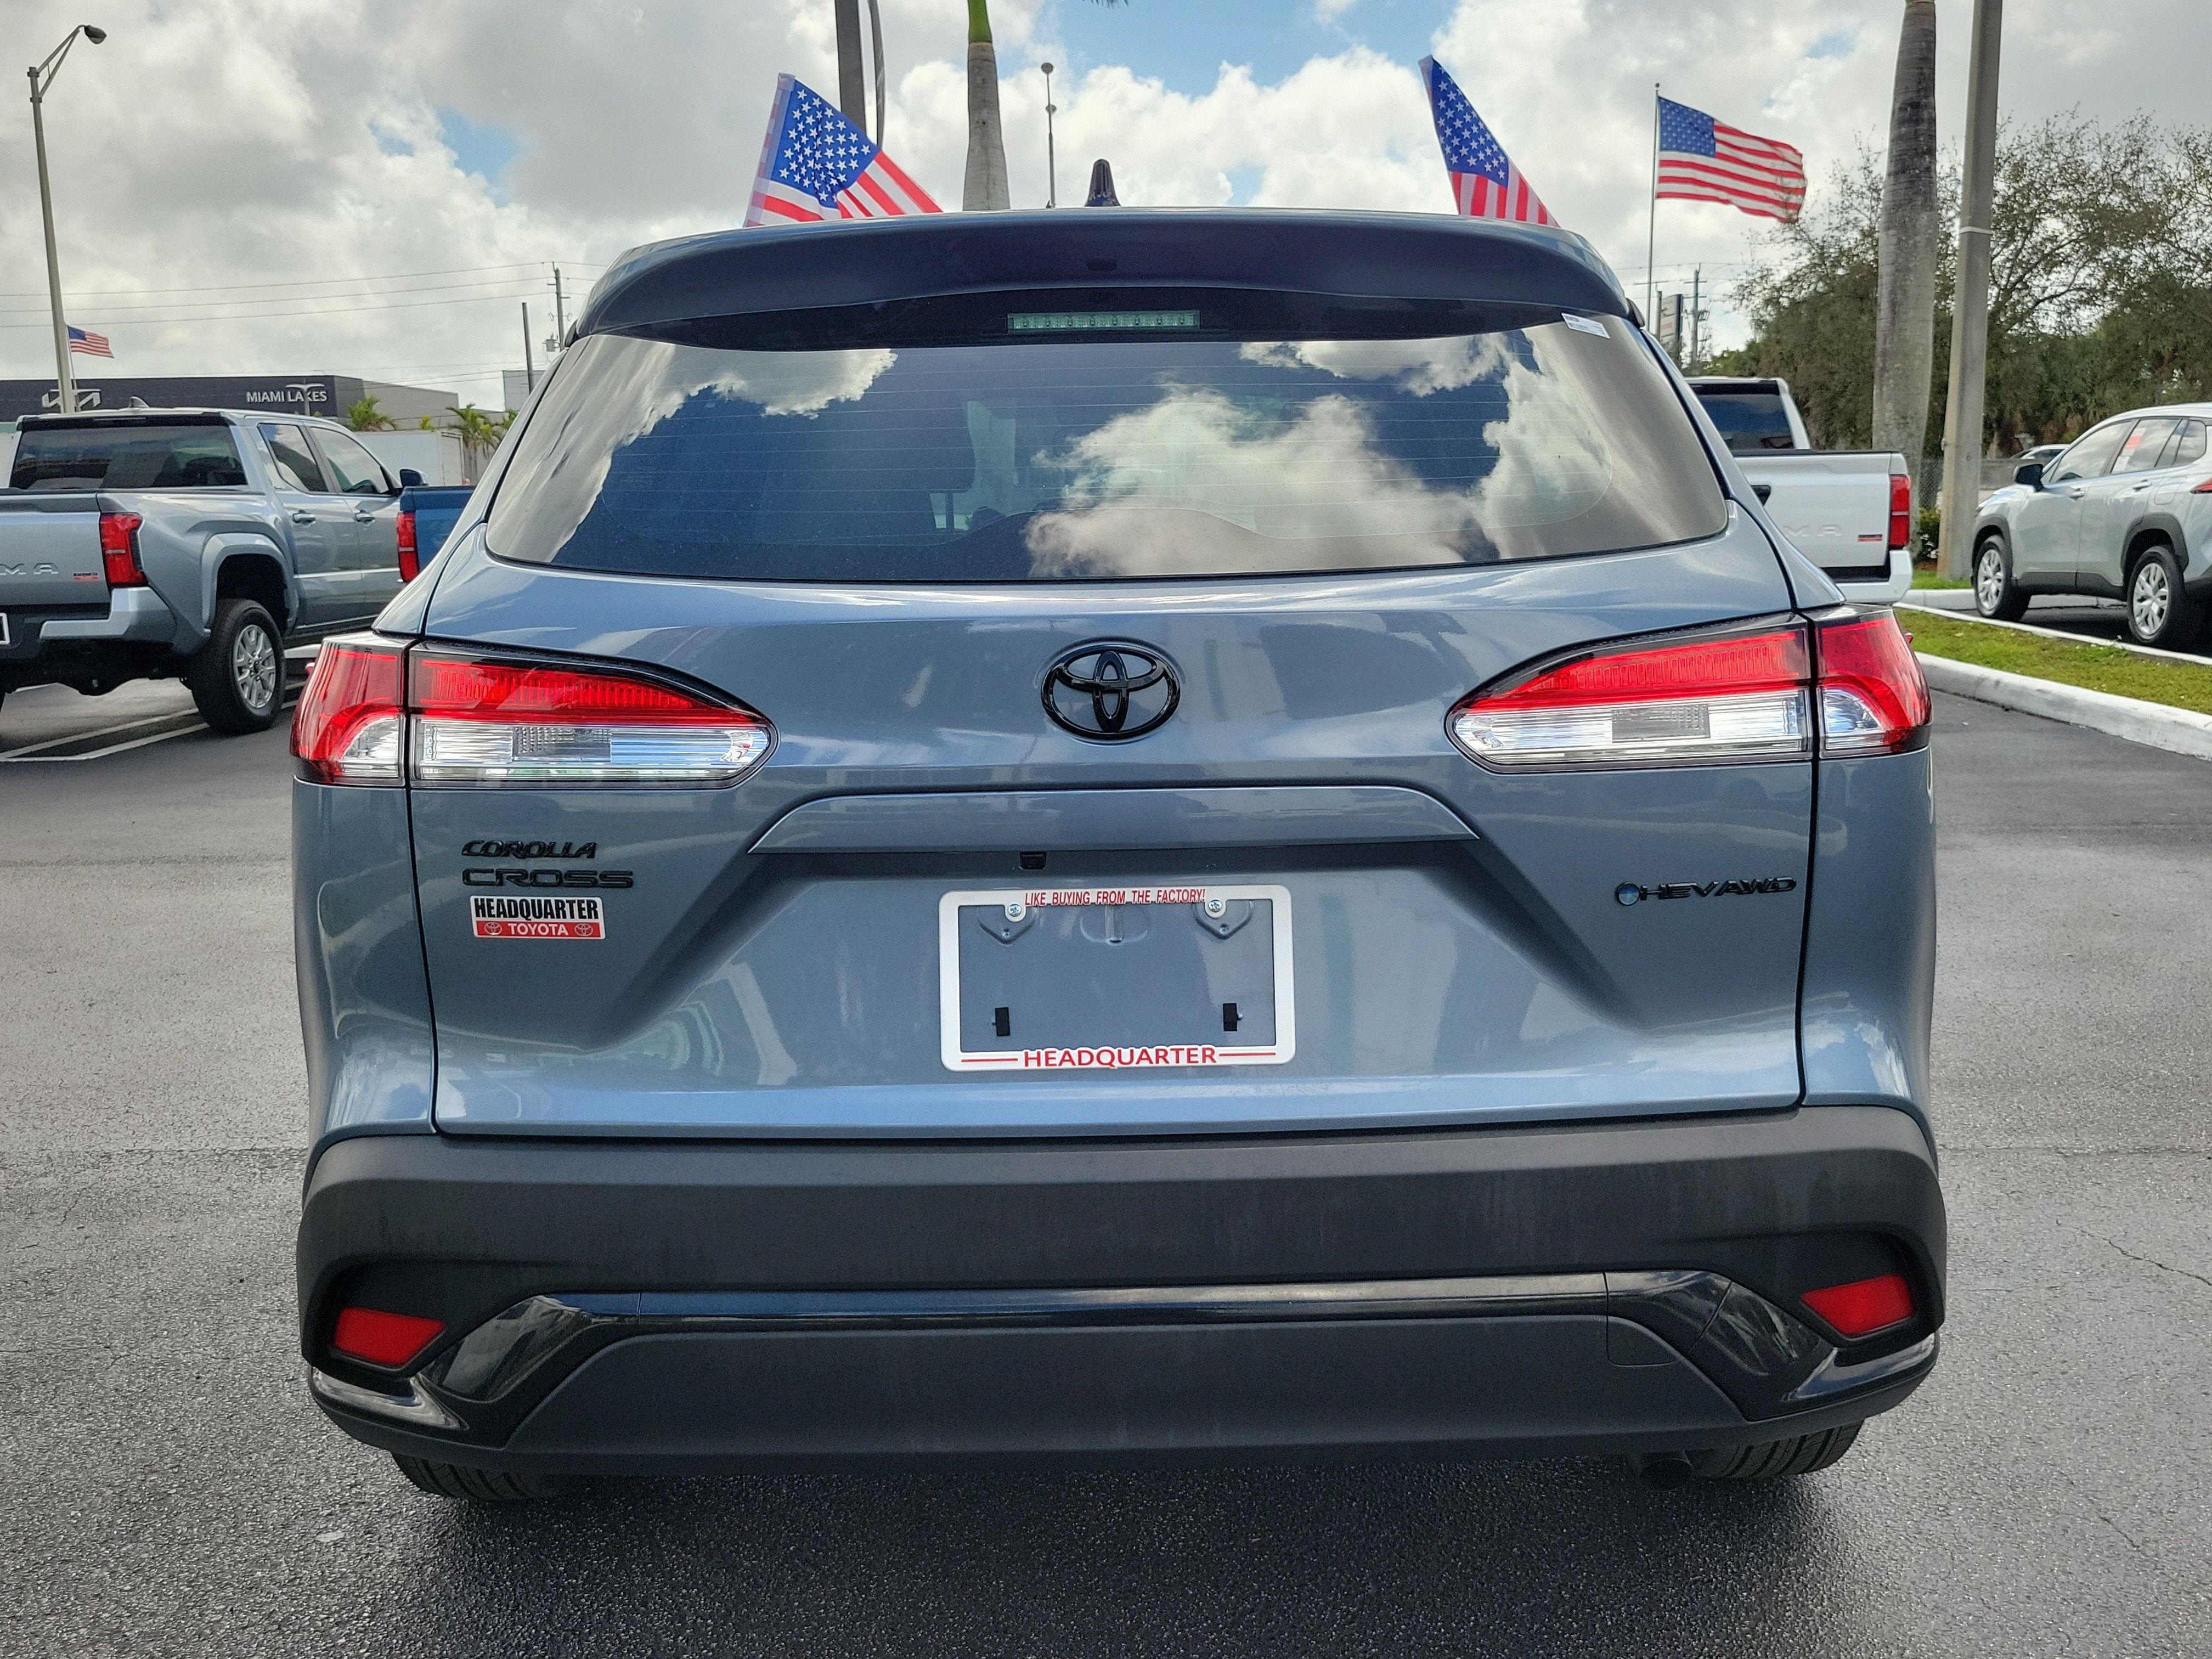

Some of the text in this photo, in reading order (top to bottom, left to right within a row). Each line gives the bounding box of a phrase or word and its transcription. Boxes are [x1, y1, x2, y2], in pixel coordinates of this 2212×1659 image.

[247, 391, 328, 403] MIAMI LAKES
[461, 840, 597, 859] COROLLA
[462, 868, 634, 888] CROSS
[1025, 889, 1206, 906] LIKE BUYING FROM THE FACTORY!
[474, 898, 599, 921] HEADQUARTER
[507, 923, 569, 936] TOYOTA
[1024, 1046, 1217, 1068] HEADQUARTER
